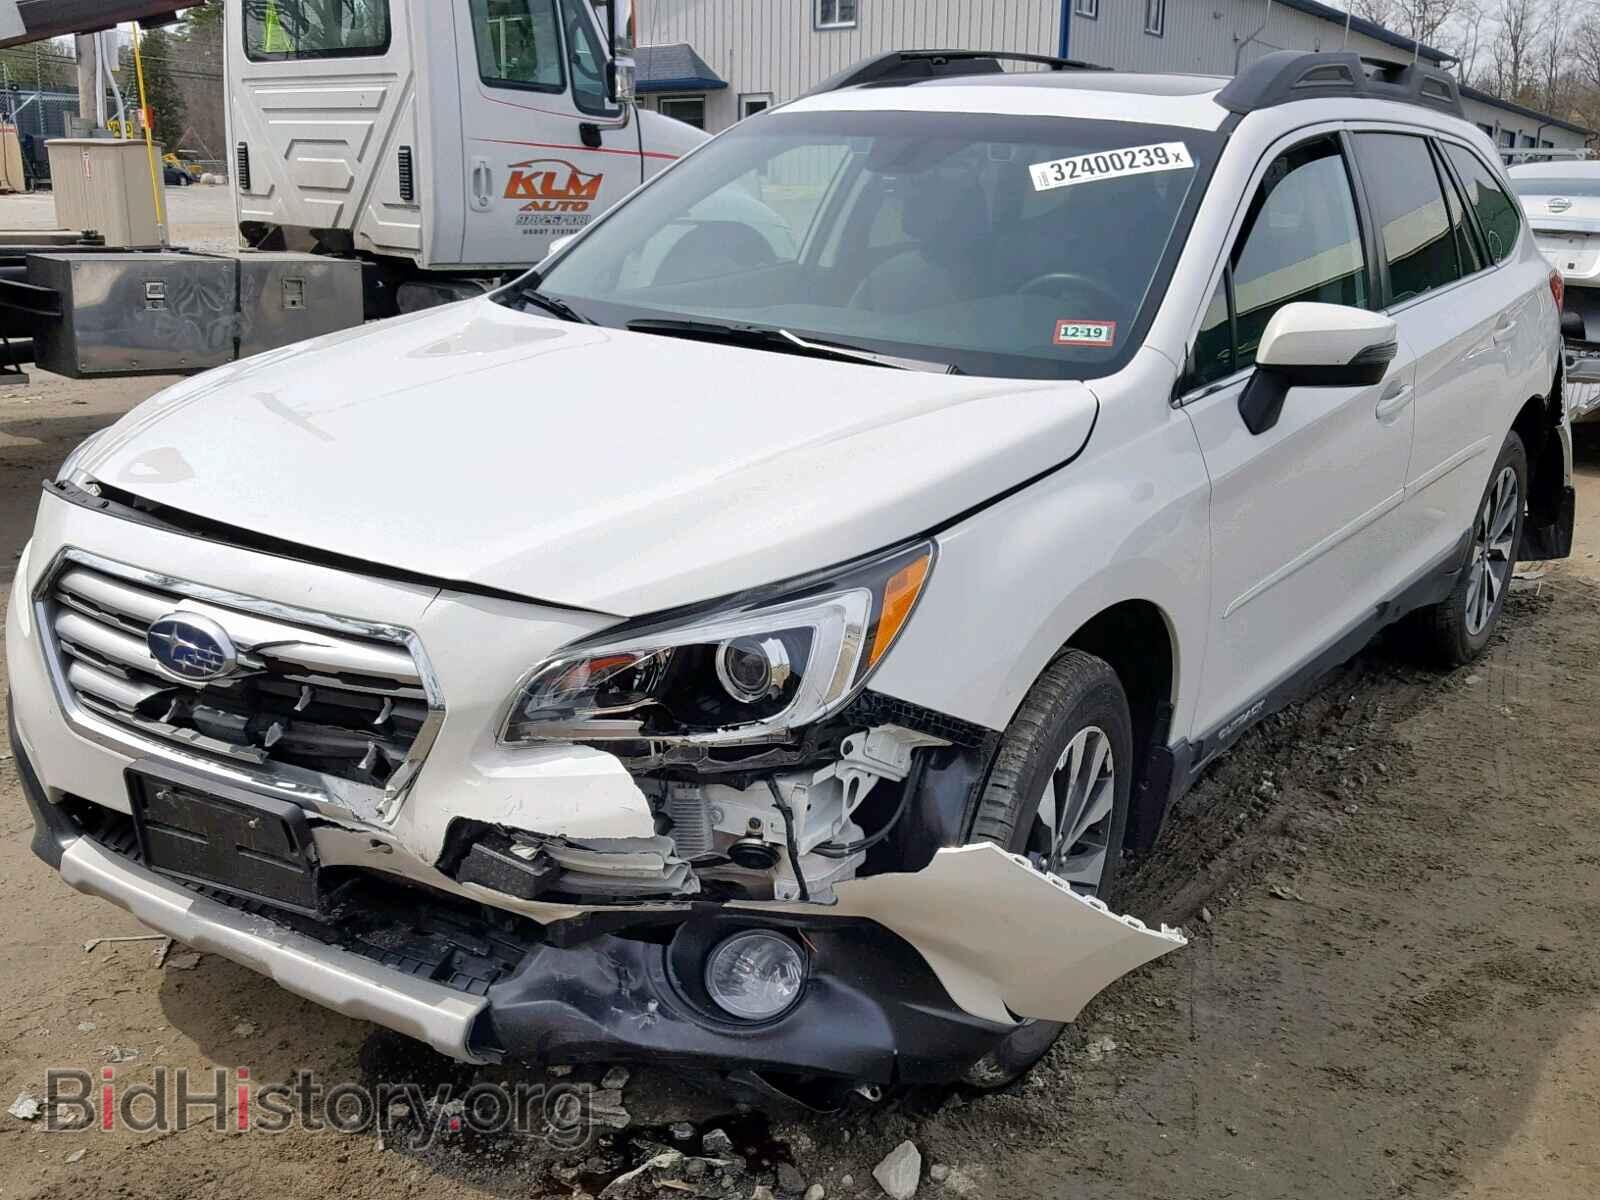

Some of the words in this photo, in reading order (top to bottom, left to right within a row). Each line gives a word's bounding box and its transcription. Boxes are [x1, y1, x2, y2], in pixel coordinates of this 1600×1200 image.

[1050, 146, 1170, 182] 32400239
[504, 170, 604, 200] KLM
[519, 201, 589, 212] AUTO
[1061, 326, 1103, 338] 12-19
